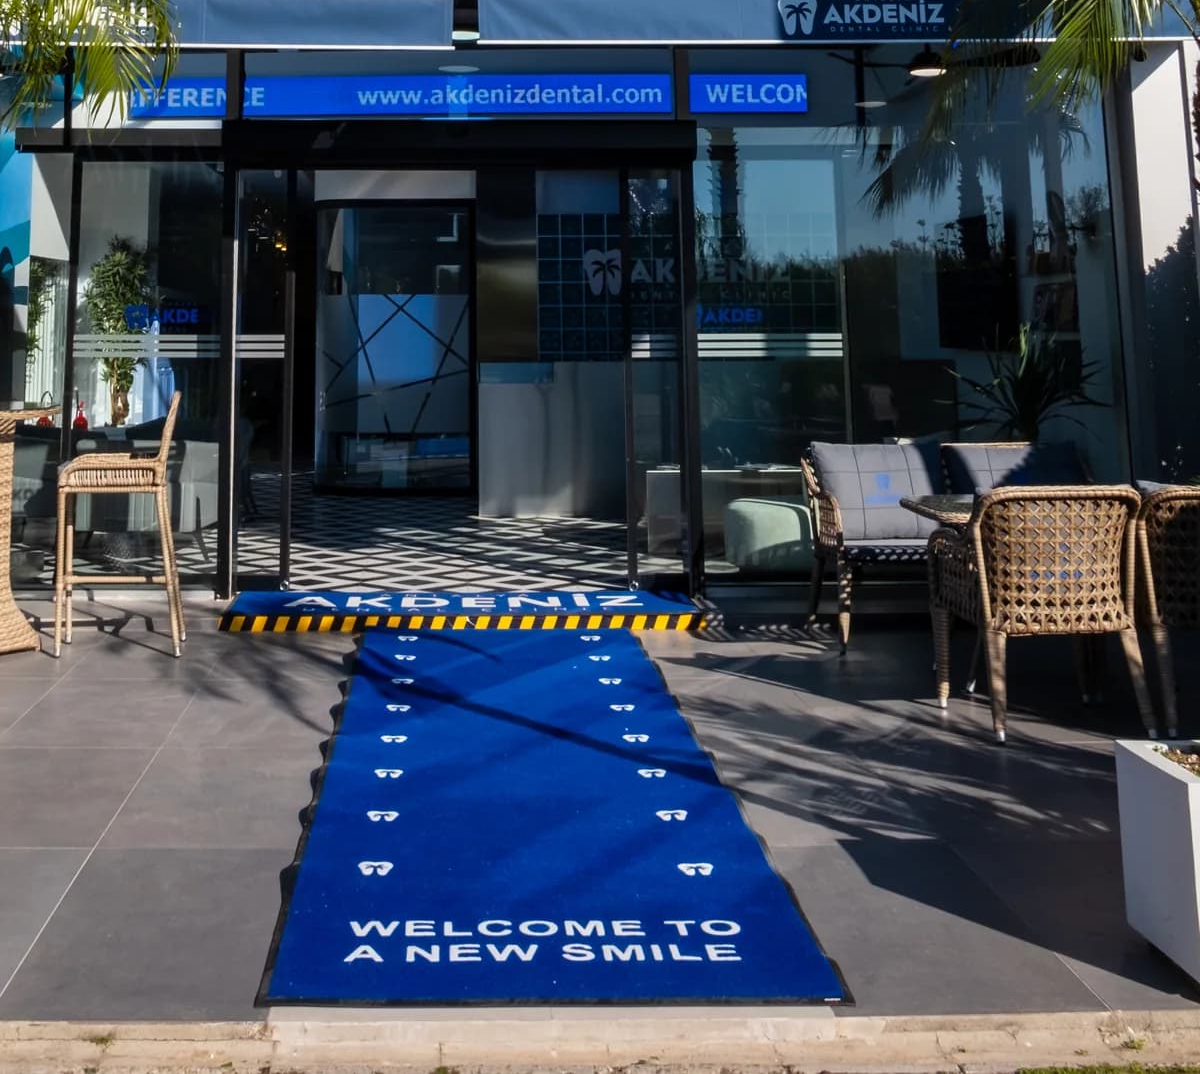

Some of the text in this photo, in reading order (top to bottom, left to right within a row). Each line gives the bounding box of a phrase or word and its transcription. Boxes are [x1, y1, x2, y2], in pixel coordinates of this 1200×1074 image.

[357, 84, 662, 105] www.akdenizdental.com
[350, 919, 741, 937] WELCOME TO
[343, 943, 742, 963] A NEW SMILE
